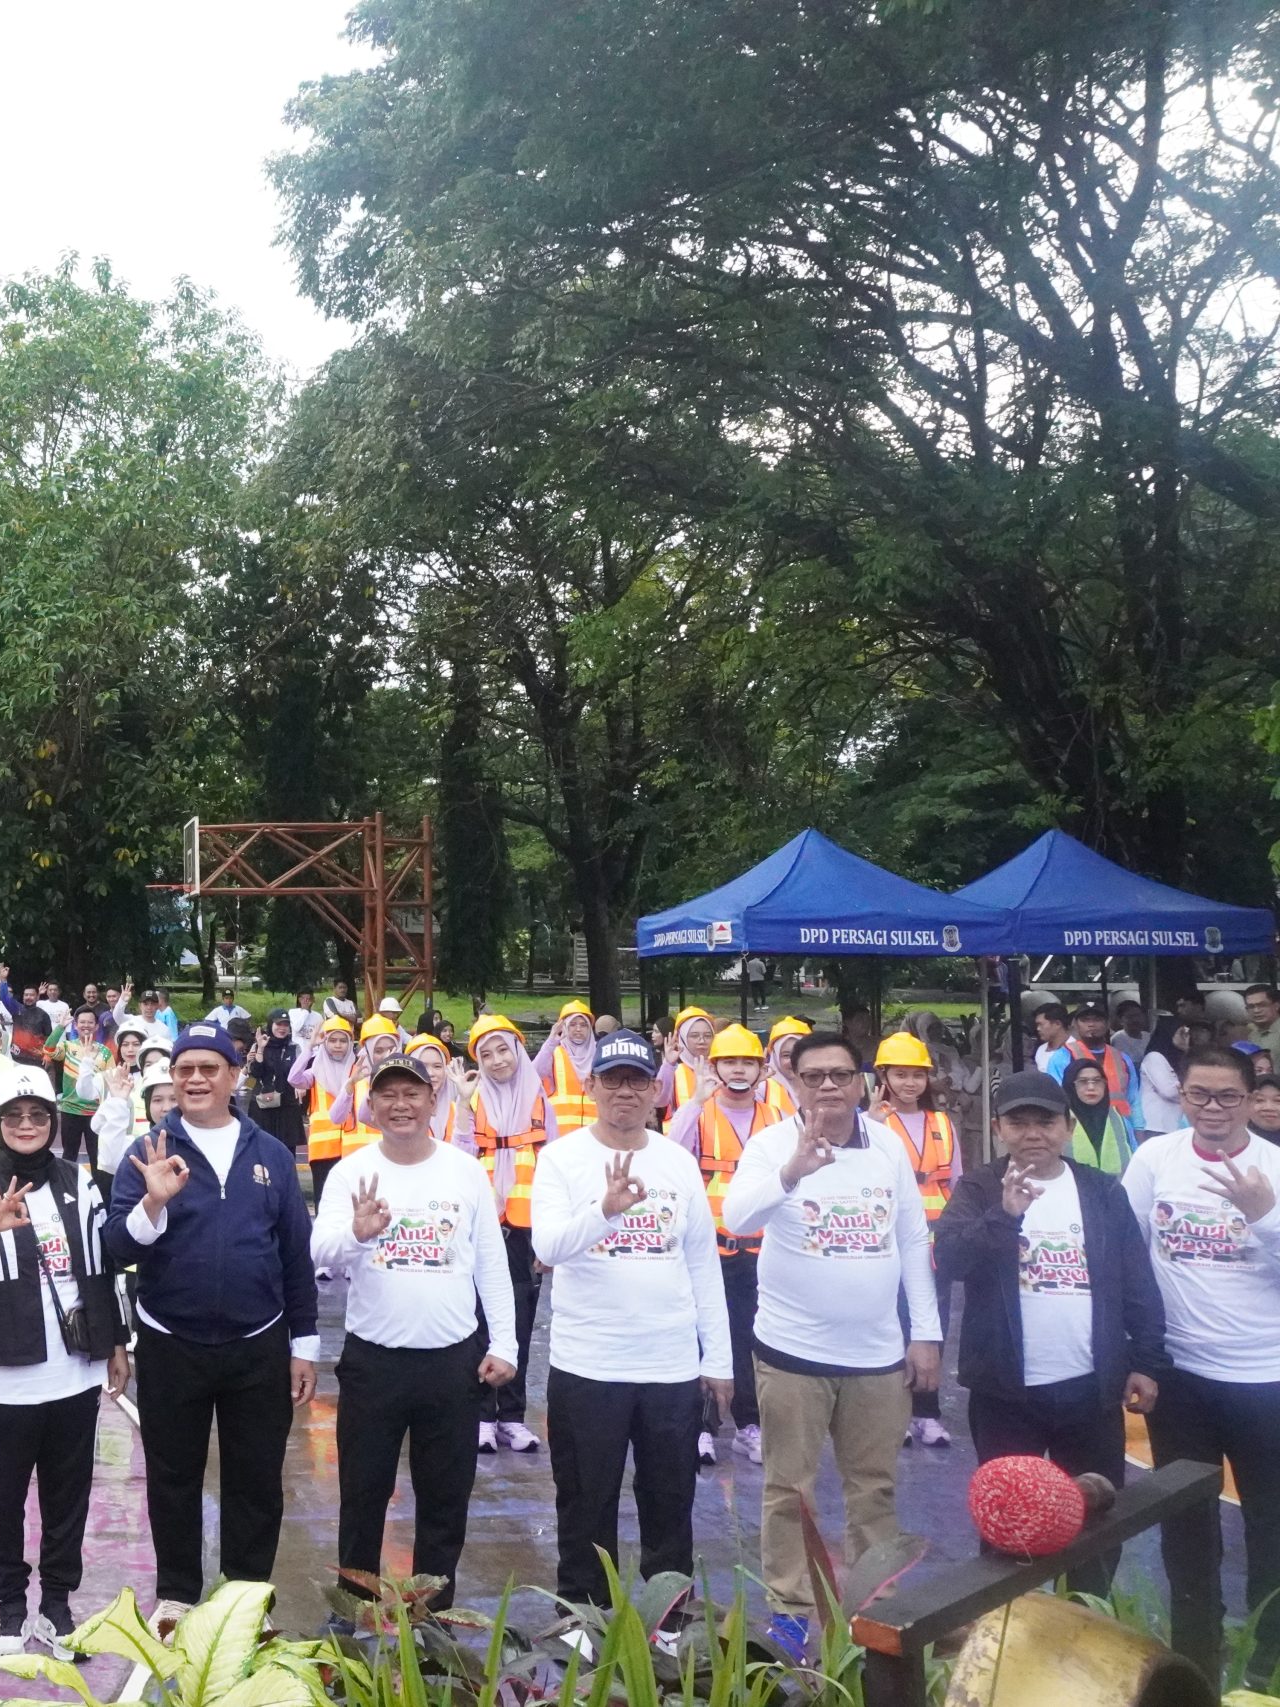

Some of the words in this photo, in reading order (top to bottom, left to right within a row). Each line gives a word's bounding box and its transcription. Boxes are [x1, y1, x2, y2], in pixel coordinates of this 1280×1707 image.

[800, 928, 829, 944] DPD
[832, 929, 887, 945] PERSAGI
[890, 930, 938, 946] SULSEL
[1064, 931, 1092, 946] DPD
[1095, 931, 1150, 946] PERSAGI
[1152, 931, 1198, 947] SULSEL
[830, 1213, 871, 1229] Anti
[396, 1225, 434, 1241] Anti
[1178, 1220, 1225, 1240] Anti
[818, 1229, 881, 1251] Mager
[384, 1242, 444, 1263] Mager
[1039, 1248, 1079, 1265] Anti
